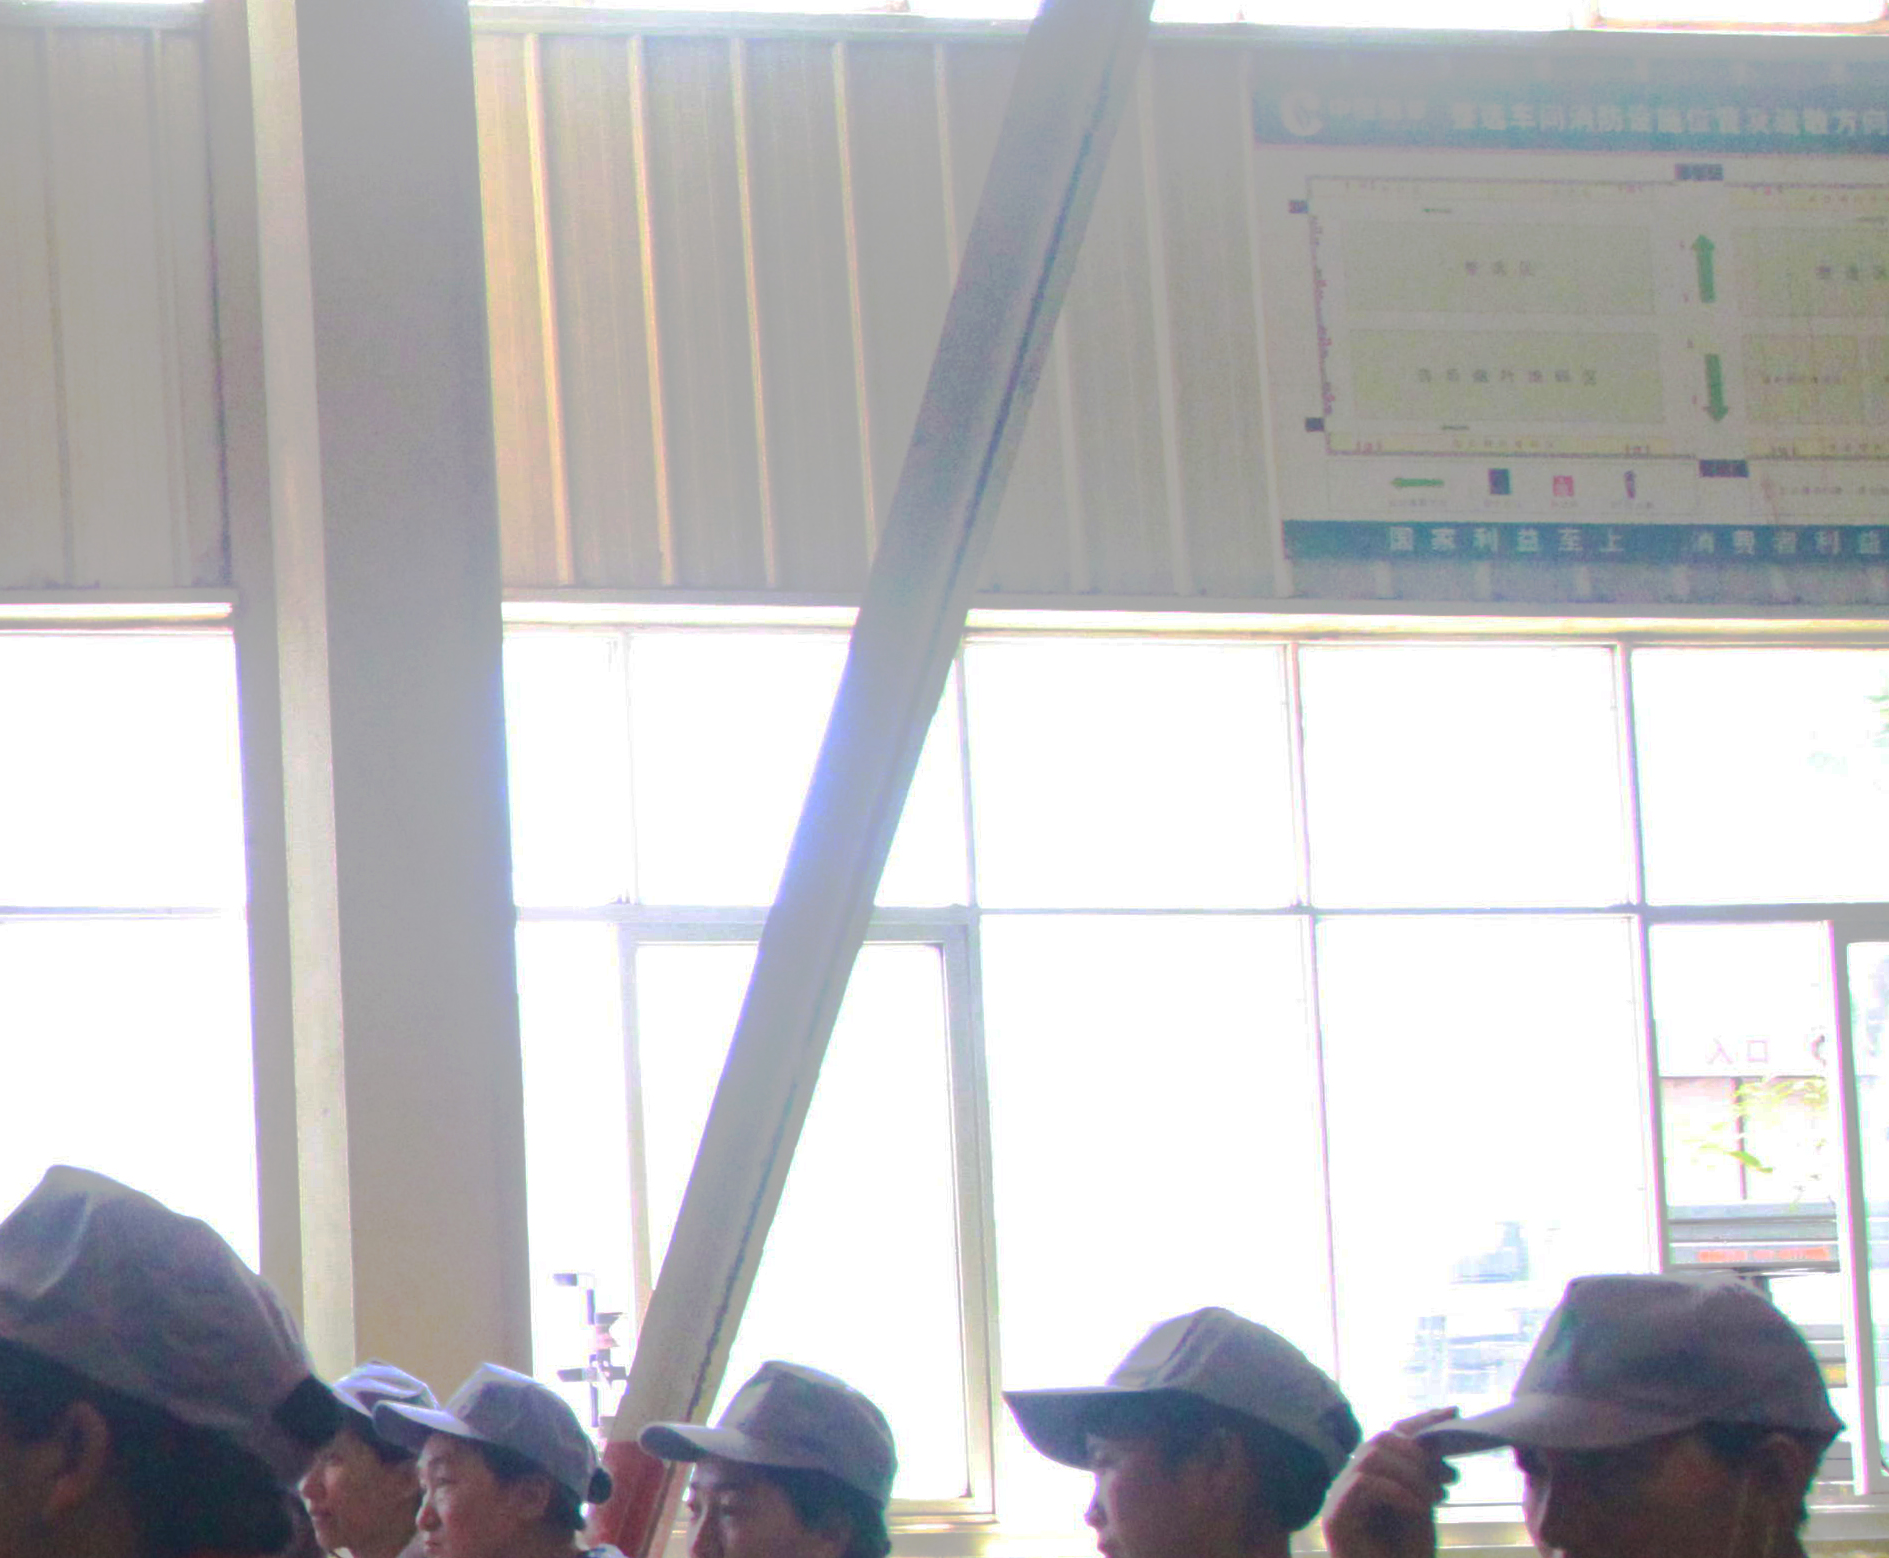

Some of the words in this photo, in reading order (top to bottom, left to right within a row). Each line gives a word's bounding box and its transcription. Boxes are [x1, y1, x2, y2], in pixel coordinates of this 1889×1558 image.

[1388, 526, 1625, 554] 国家利益至上
